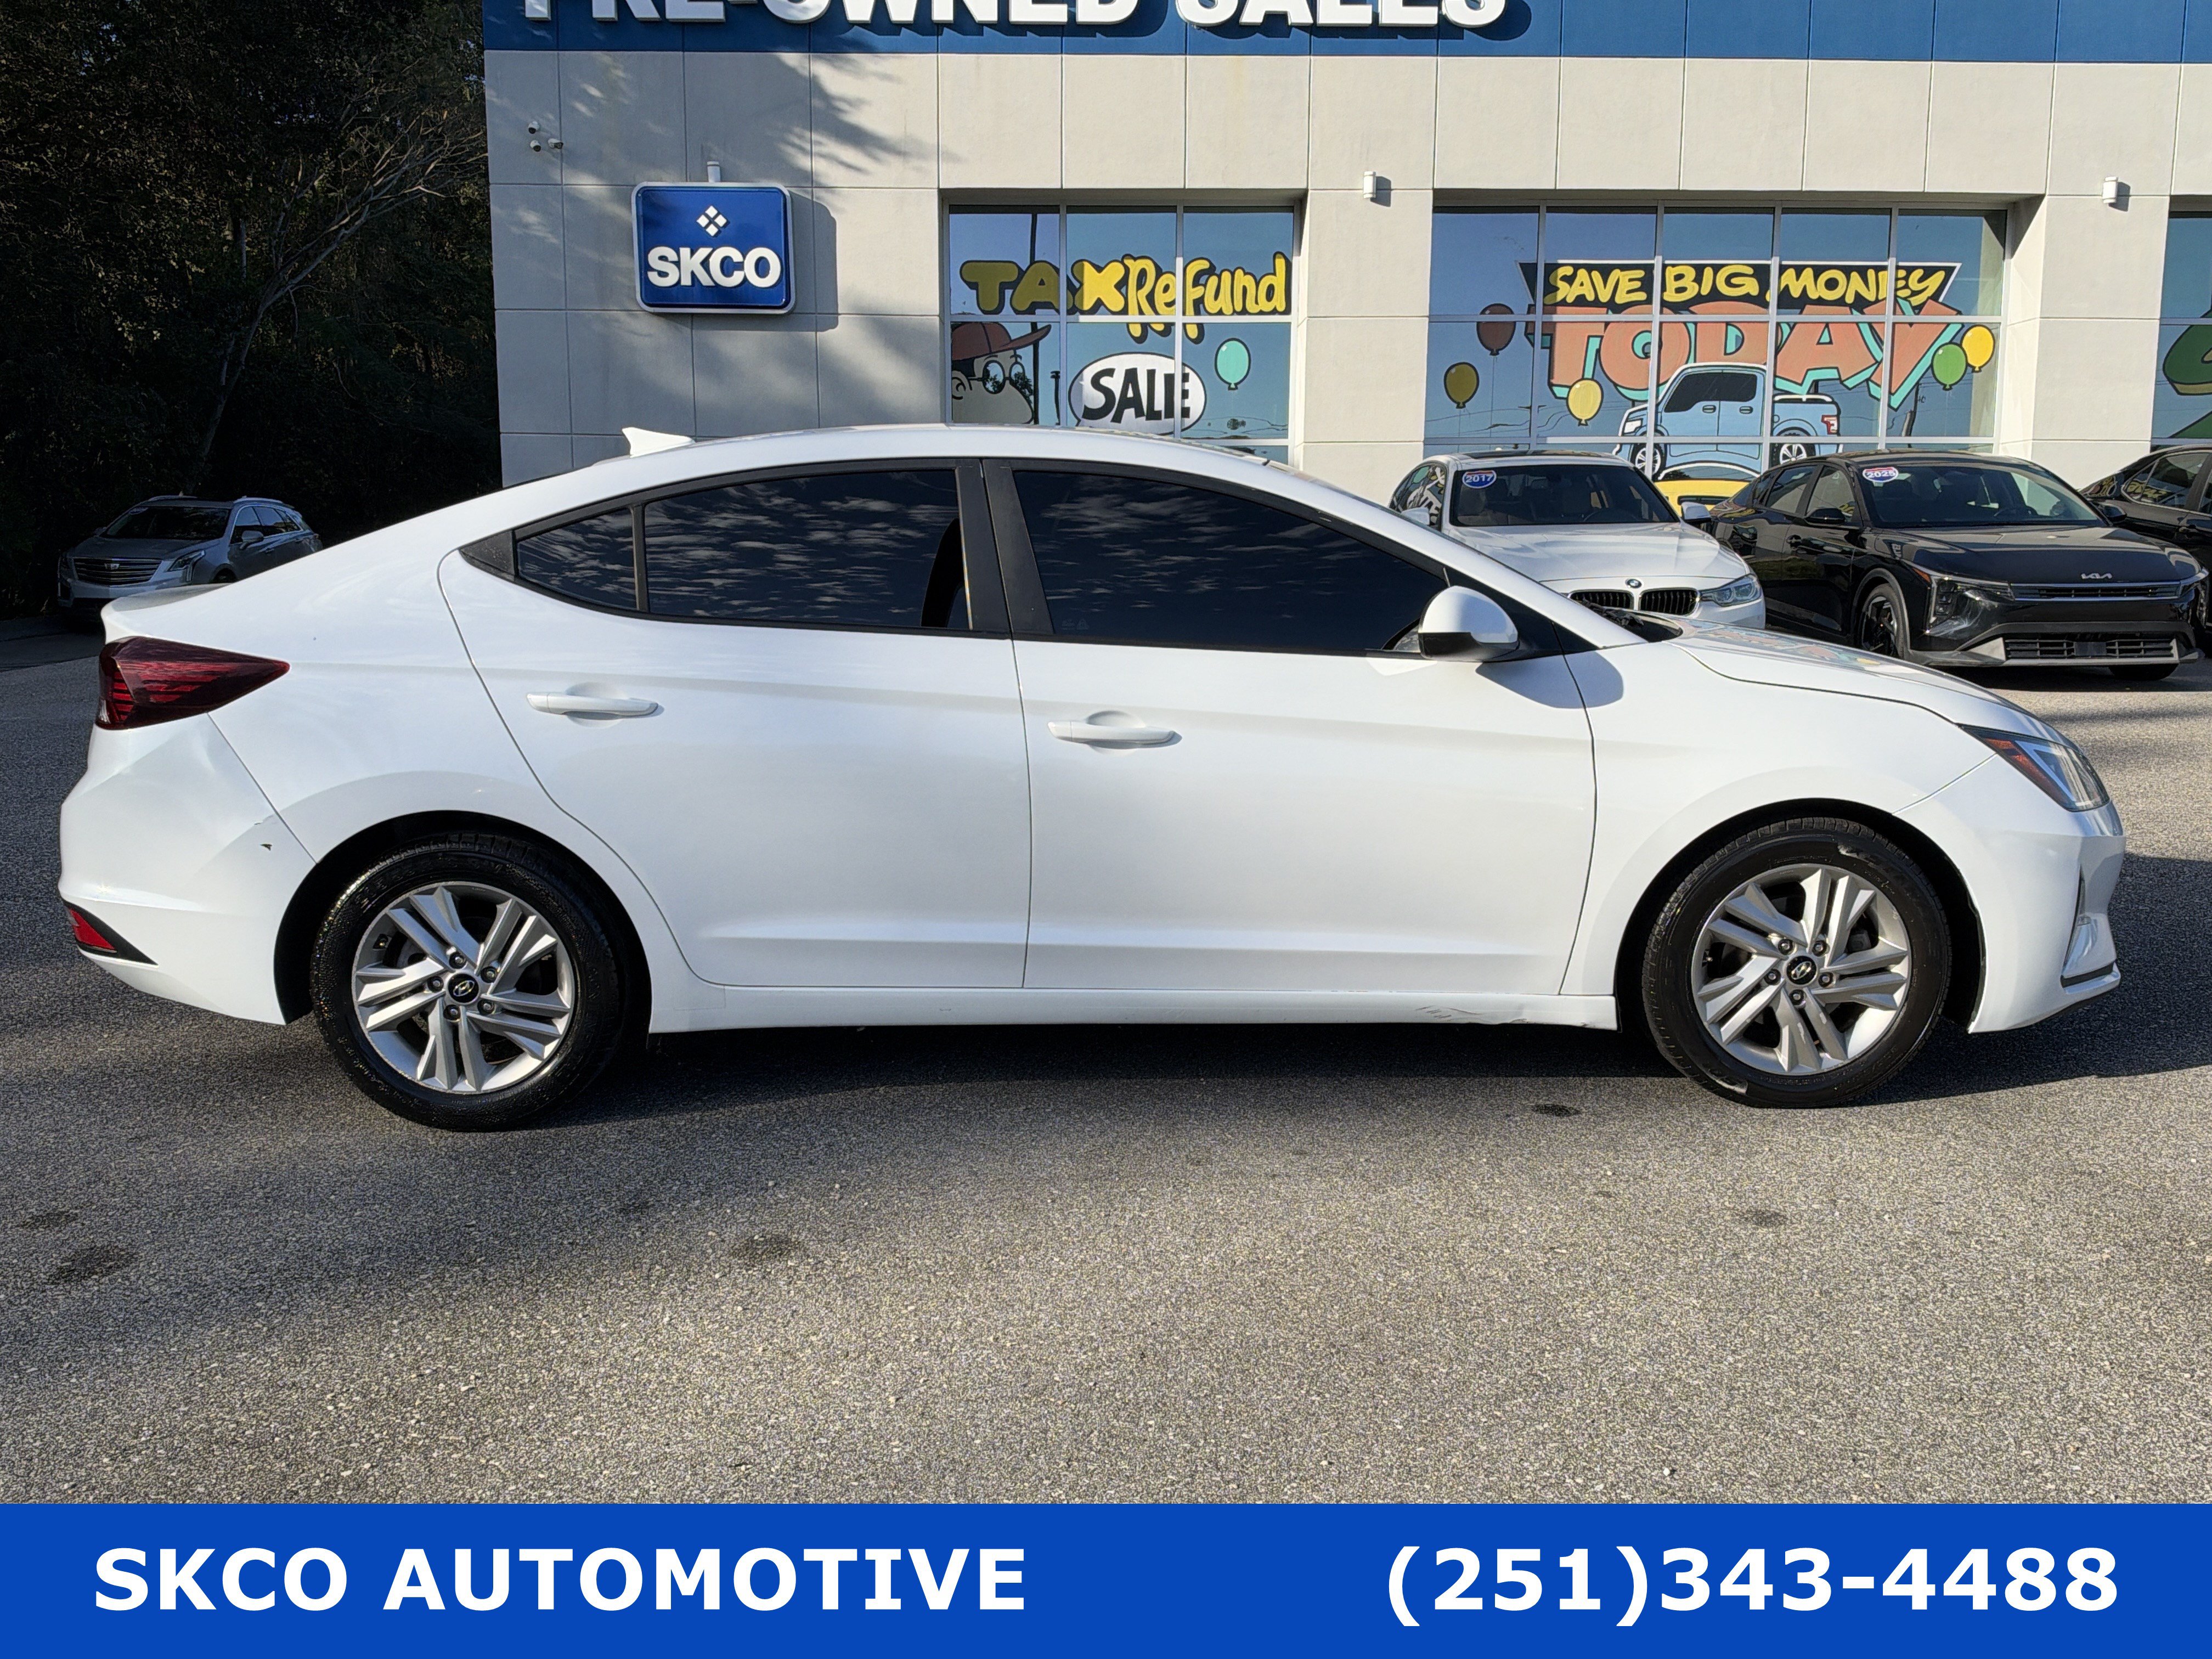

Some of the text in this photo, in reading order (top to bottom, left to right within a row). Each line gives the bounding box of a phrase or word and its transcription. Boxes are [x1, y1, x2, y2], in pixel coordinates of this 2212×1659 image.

[647, 246, 782, 287] SKCO
[960, 259, 1125, 314] TAX
[1543, 264, 1946, 306] SAVE BIG MONEY
[1526, 298, 1963, 411] TODAY
[1081, 367, 1190, 424] SALE
[1465, 475, 1493, 483] 2017
